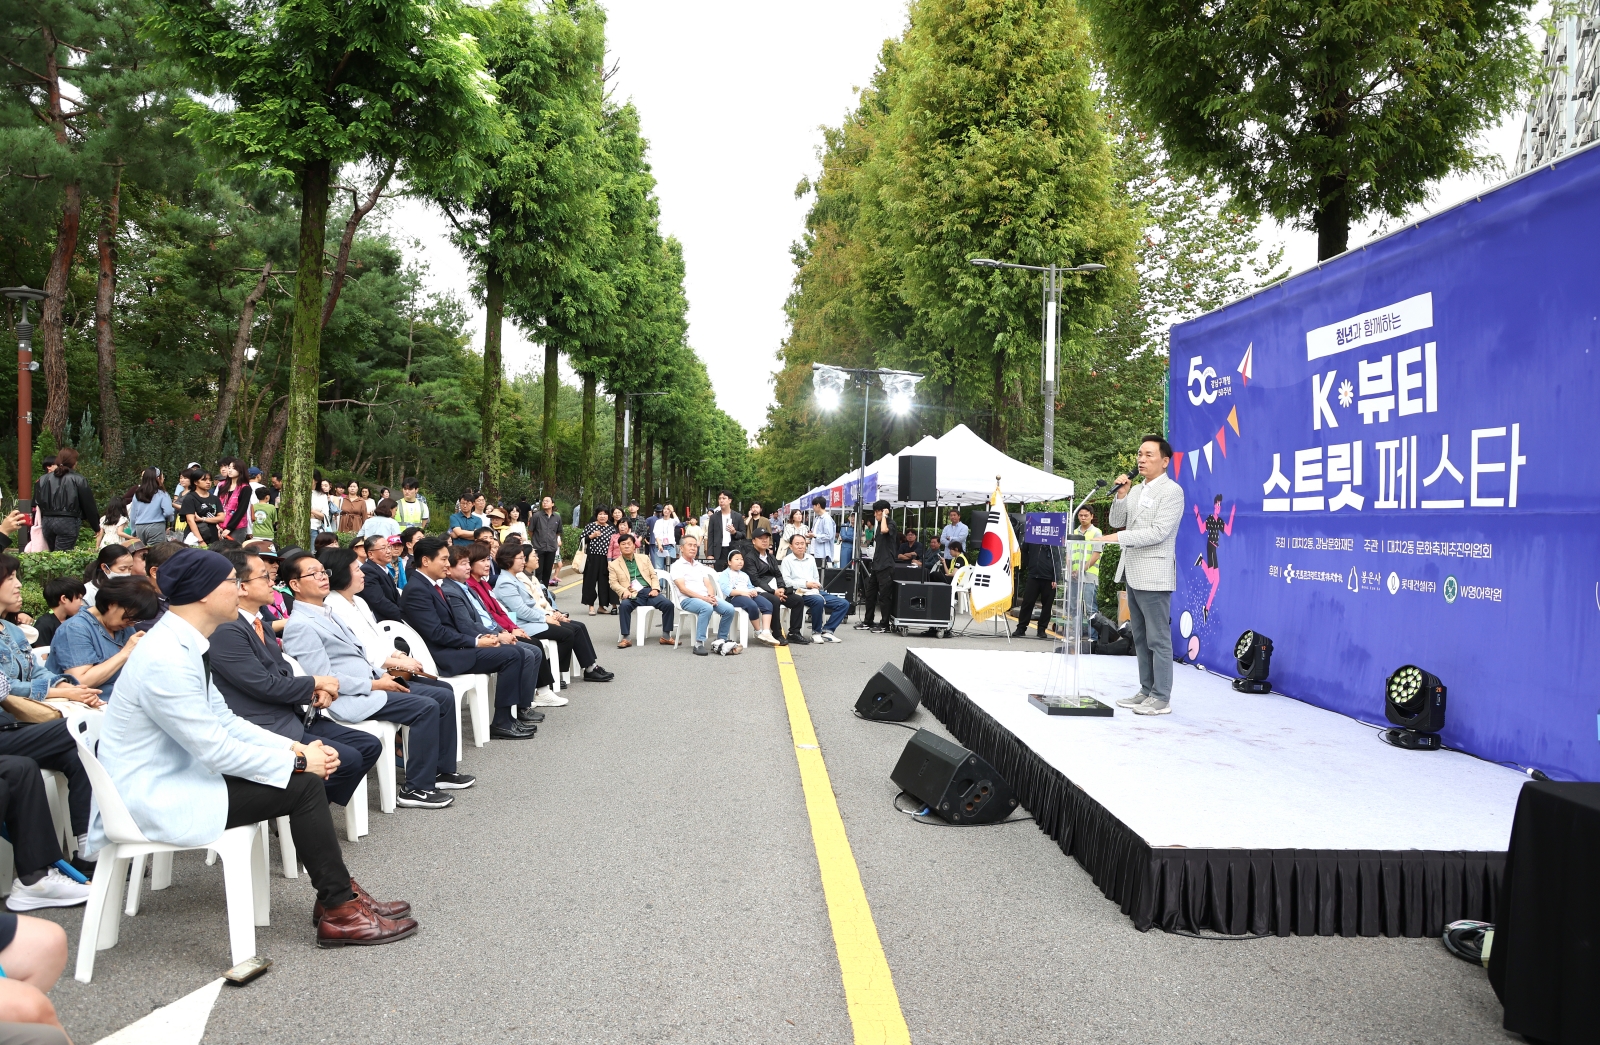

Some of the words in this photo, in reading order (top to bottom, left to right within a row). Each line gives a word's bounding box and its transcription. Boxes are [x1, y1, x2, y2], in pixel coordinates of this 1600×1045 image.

[1336, 322, 1362, 346] 청년과
[1364, 312, 1402, 337] 함께하는
[1187, 355, 1219, 406] 50
[1312, 369, 1339, 431] K
[1358, 341, 1438, 425] 뷰티
[1262, 440, 1365, 512] 스트릿
[1373, 422, 1527, 510] 페스타
[1275, 536, 1286, 548] 주최
[1315, 537, 1354, 551] 강남문화재단
[1363, 539, 1379, 553] 주관
[1416, 541, 1492, 558] 문화축제추진위원회
[1268, 564, 1279, 577] 후원
[1360, 570, 1382, 585] 봉은사
[1401, 578, 1436, 593] 롯데건설(주)
[1460, 585, 1503, 602] W영어학원
